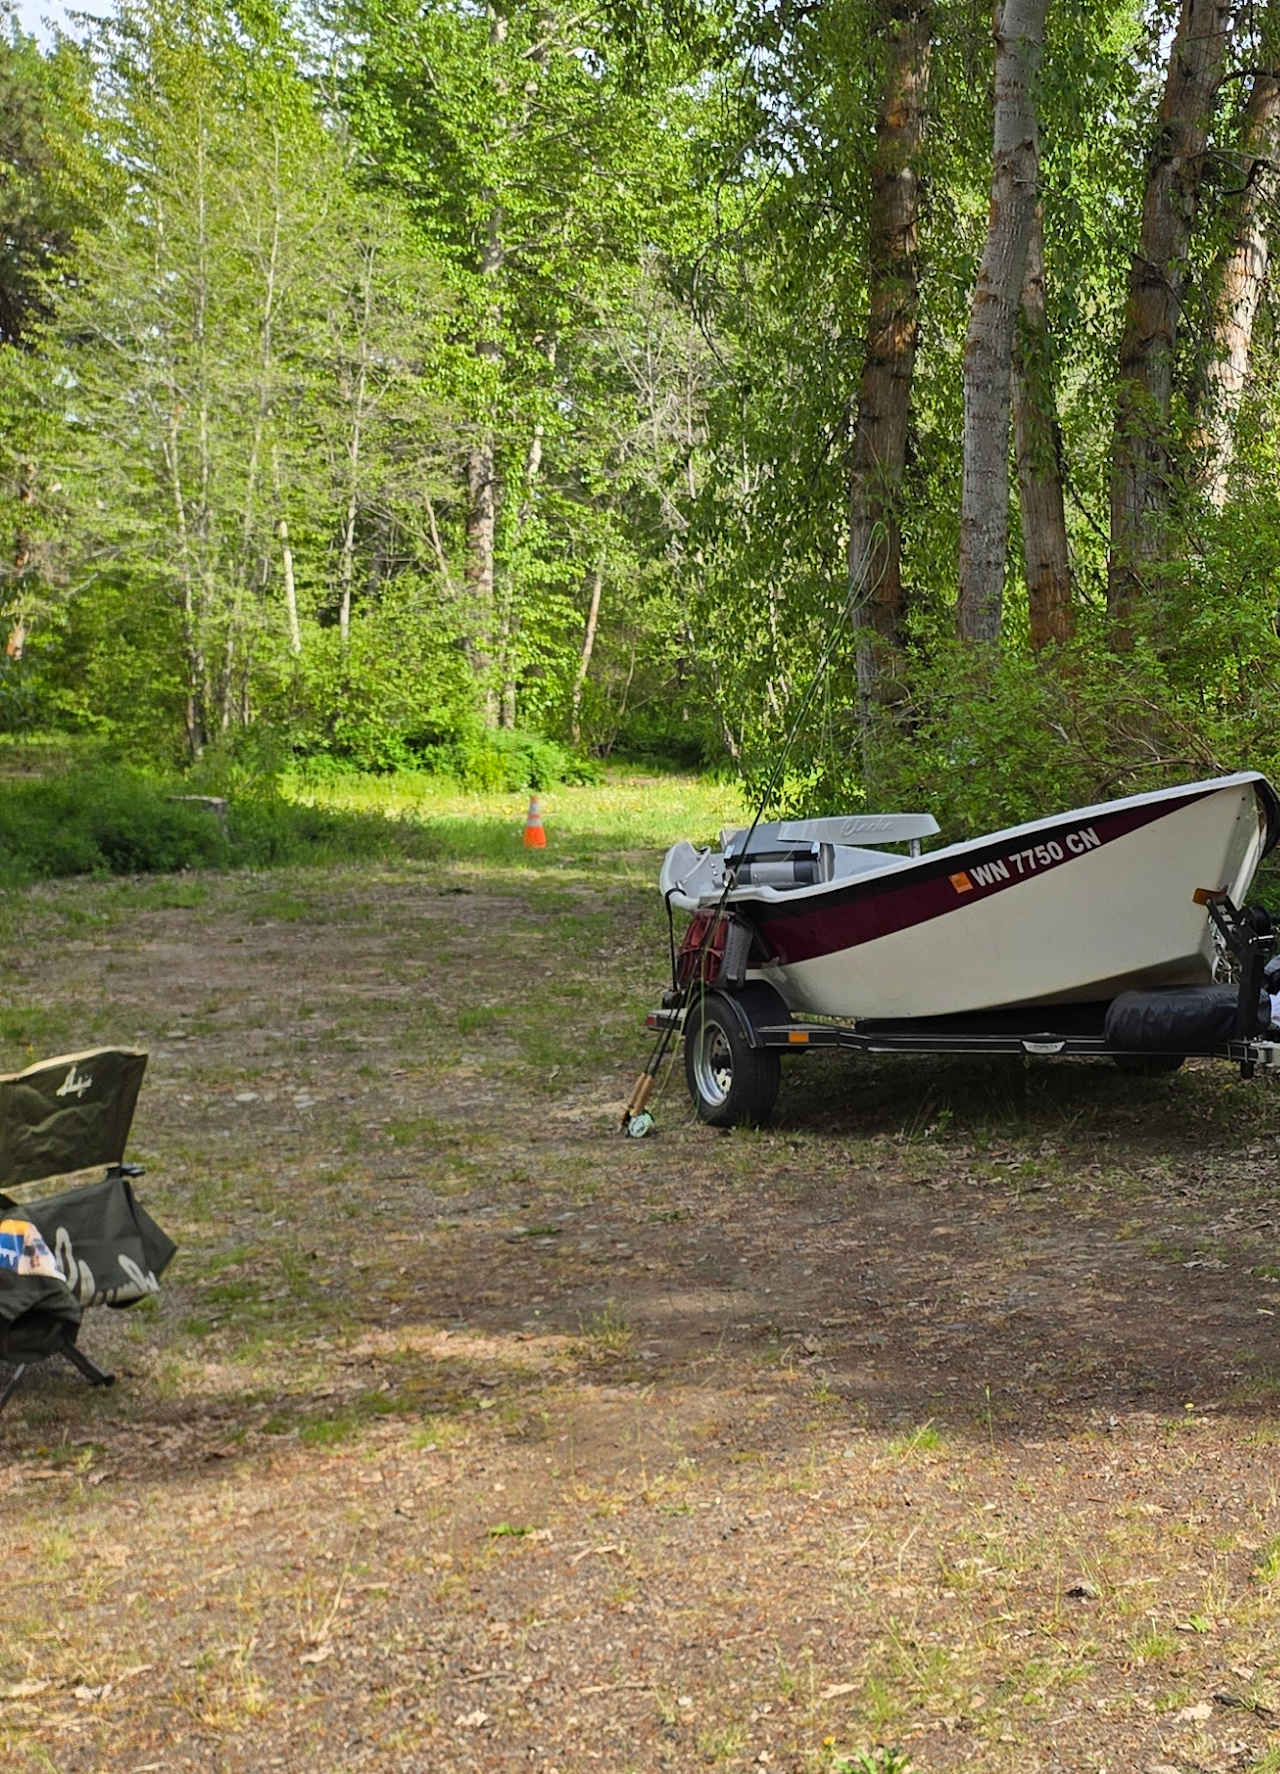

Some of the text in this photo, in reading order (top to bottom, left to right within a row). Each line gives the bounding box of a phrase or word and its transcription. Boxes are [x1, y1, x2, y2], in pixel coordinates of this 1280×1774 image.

[969, 827, 1101, 887] WN 7750 CN
